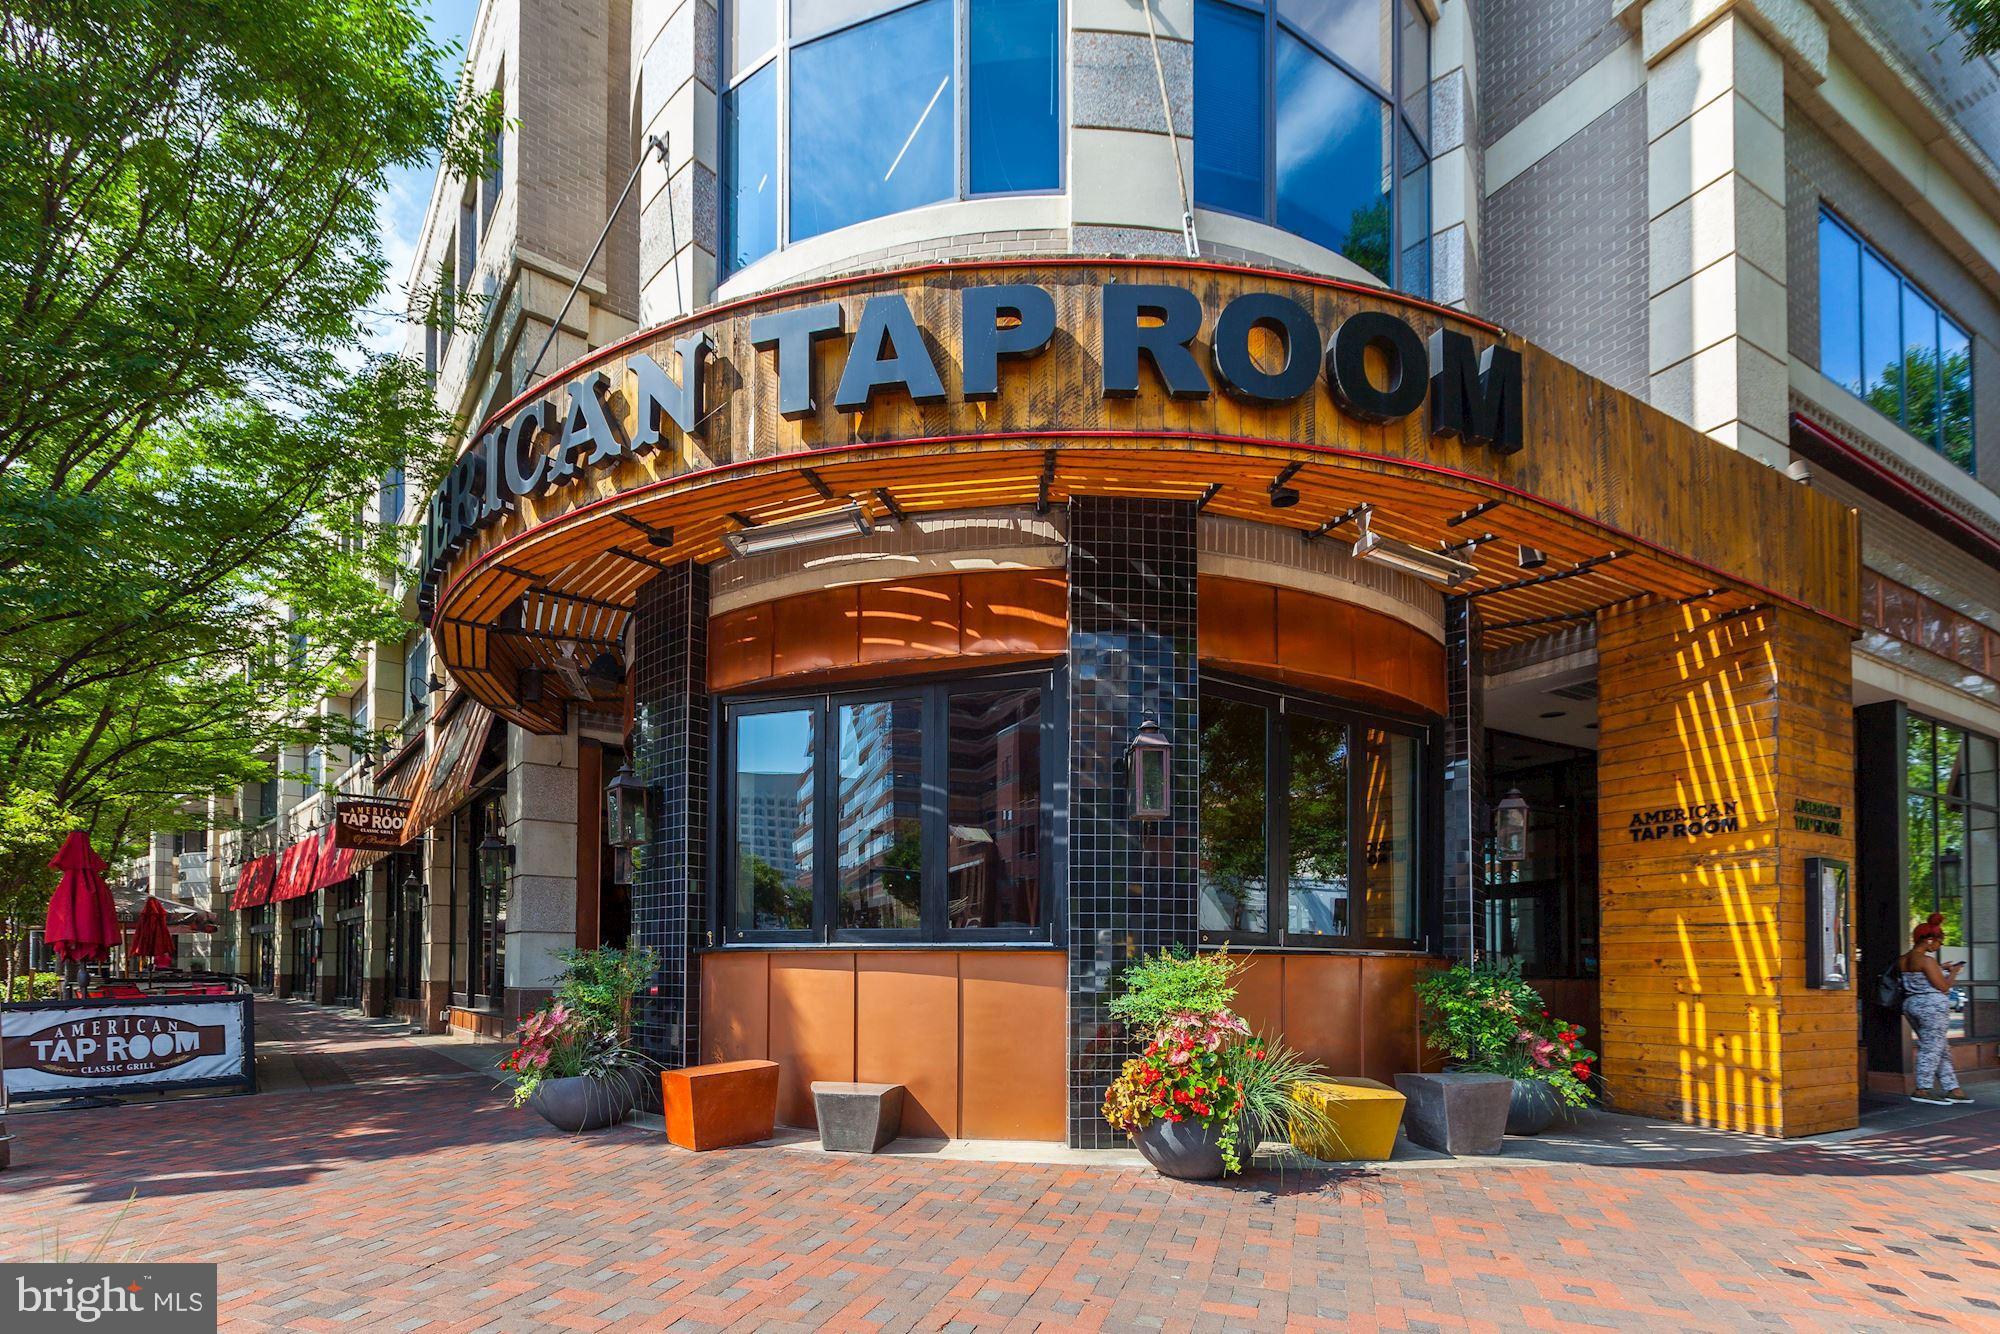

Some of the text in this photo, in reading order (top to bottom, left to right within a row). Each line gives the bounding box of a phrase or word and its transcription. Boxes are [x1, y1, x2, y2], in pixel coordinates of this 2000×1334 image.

[751, 283, 1056, 421] TAP
[1102, 283, 1523, 456] ROOM
[340, 812, 369, 827] TAP
[350, 806, 405, 818] AMERICAN
[1629, 800, 1738, 828] AMERICAN
[1629, 817, 1738, 842] TAP ROOM
[54, 1018, 179, 1039] AMERICAN
[30, 1030, 200, 1063] TAP ROOM
[81, 1062, 156, 1074] CLASSIC GRILL
